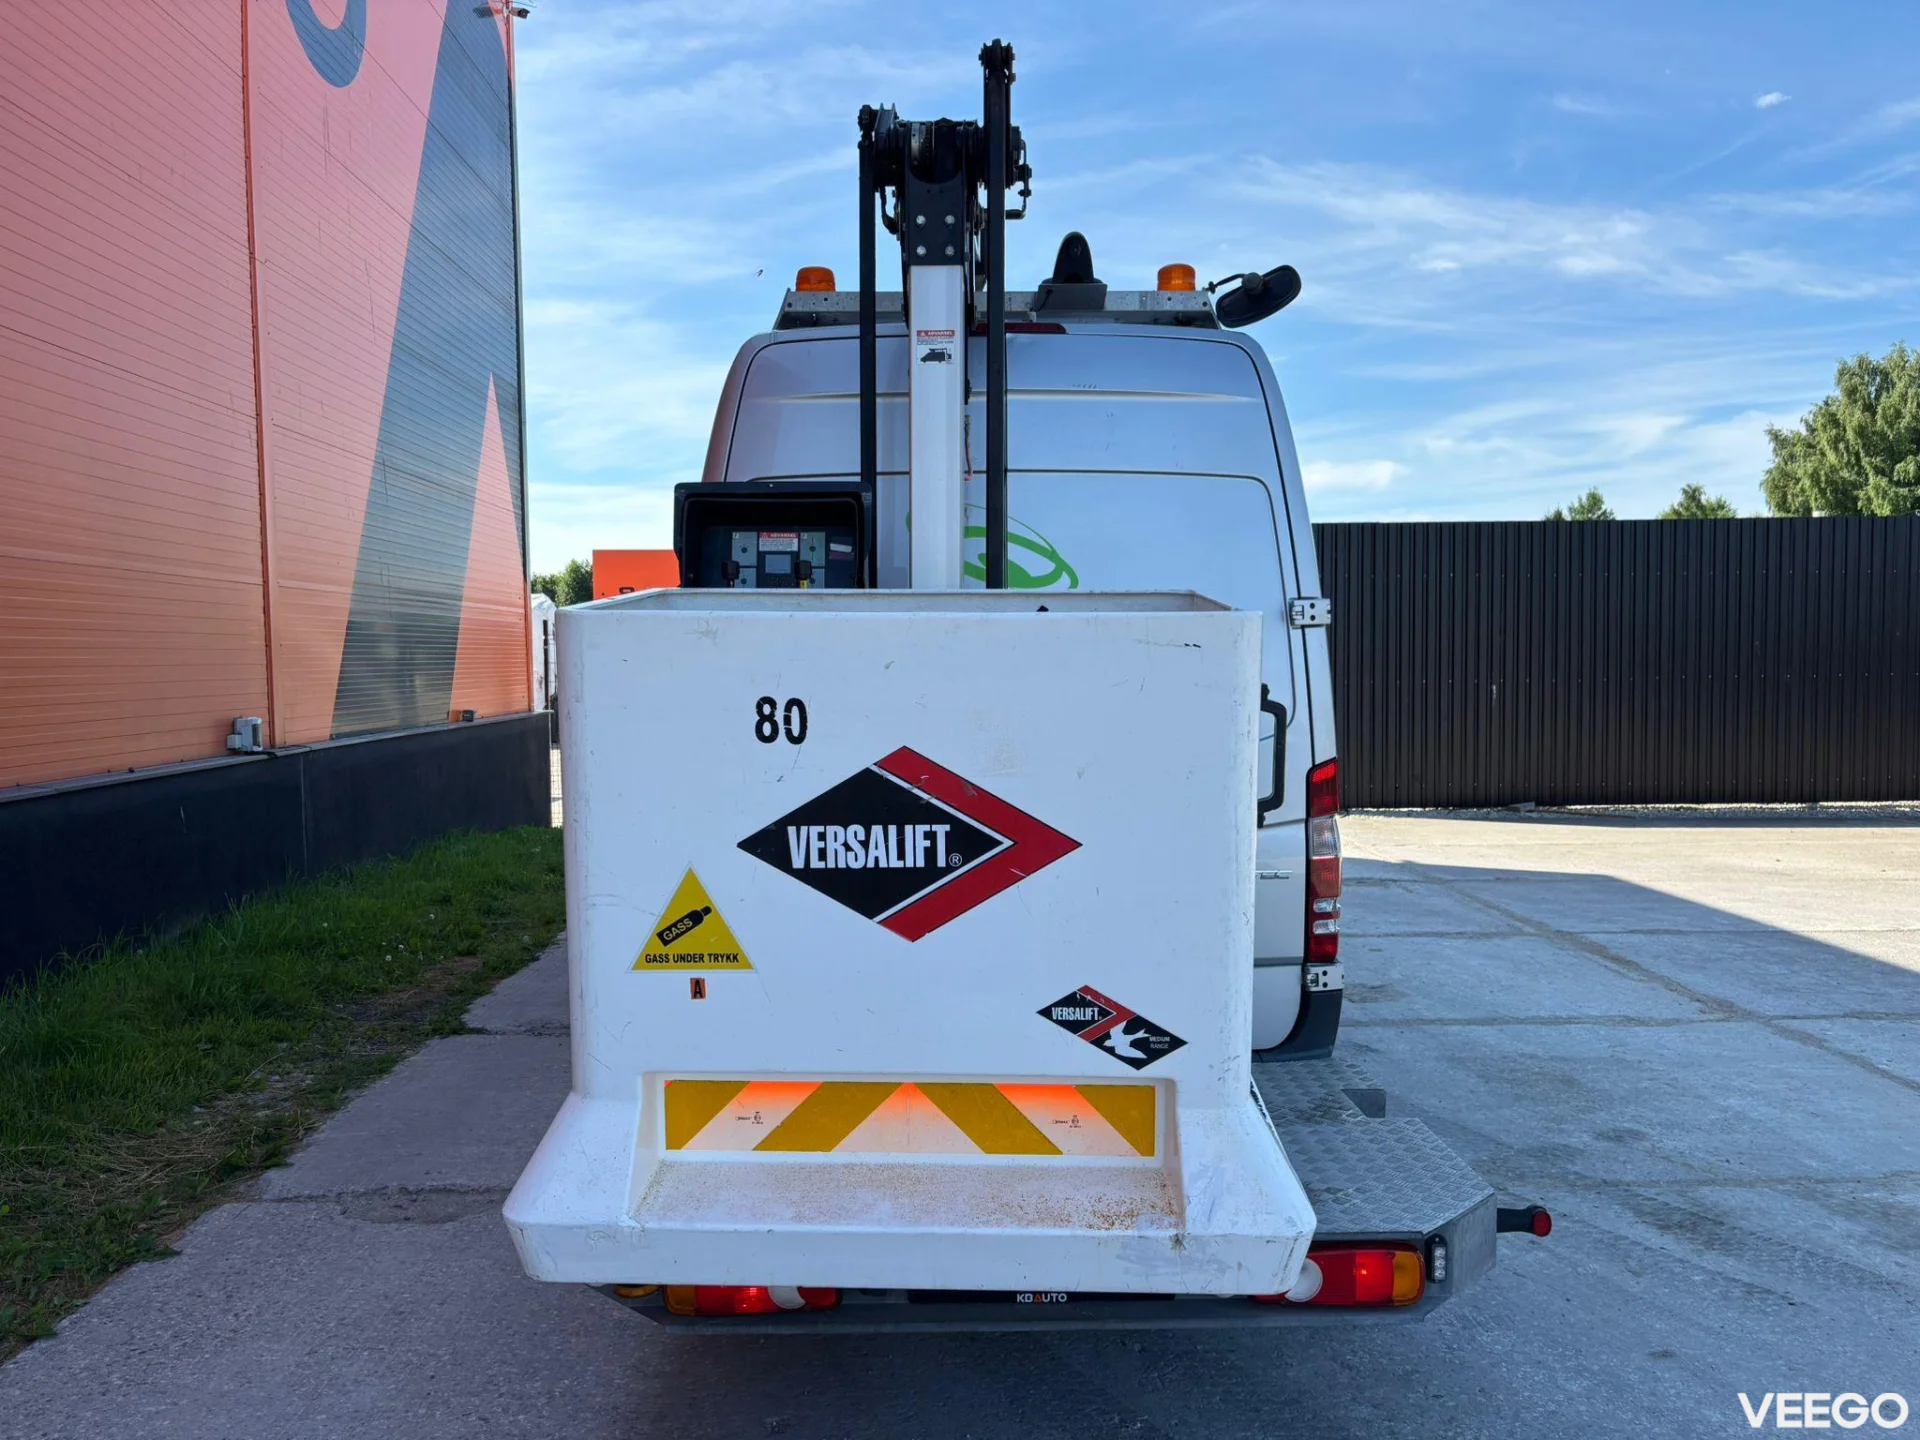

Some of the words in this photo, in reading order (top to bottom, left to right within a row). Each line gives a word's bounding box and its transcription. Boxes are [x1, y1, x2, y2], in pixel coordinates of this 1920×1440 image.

[755, 696, 808, 745] 80
[663, 918, 693, 941] GASS
[645, 953, 670, 964] GASS
[673, 953, 705, 963] UNDER
[707, 953, 739, 963] TRYKK
[693, 979, 703, 999] A
[1051, 1007, 1100, 1021] VERSALIFT
[1017, 1293, 1067, 1303] KBAUTO
